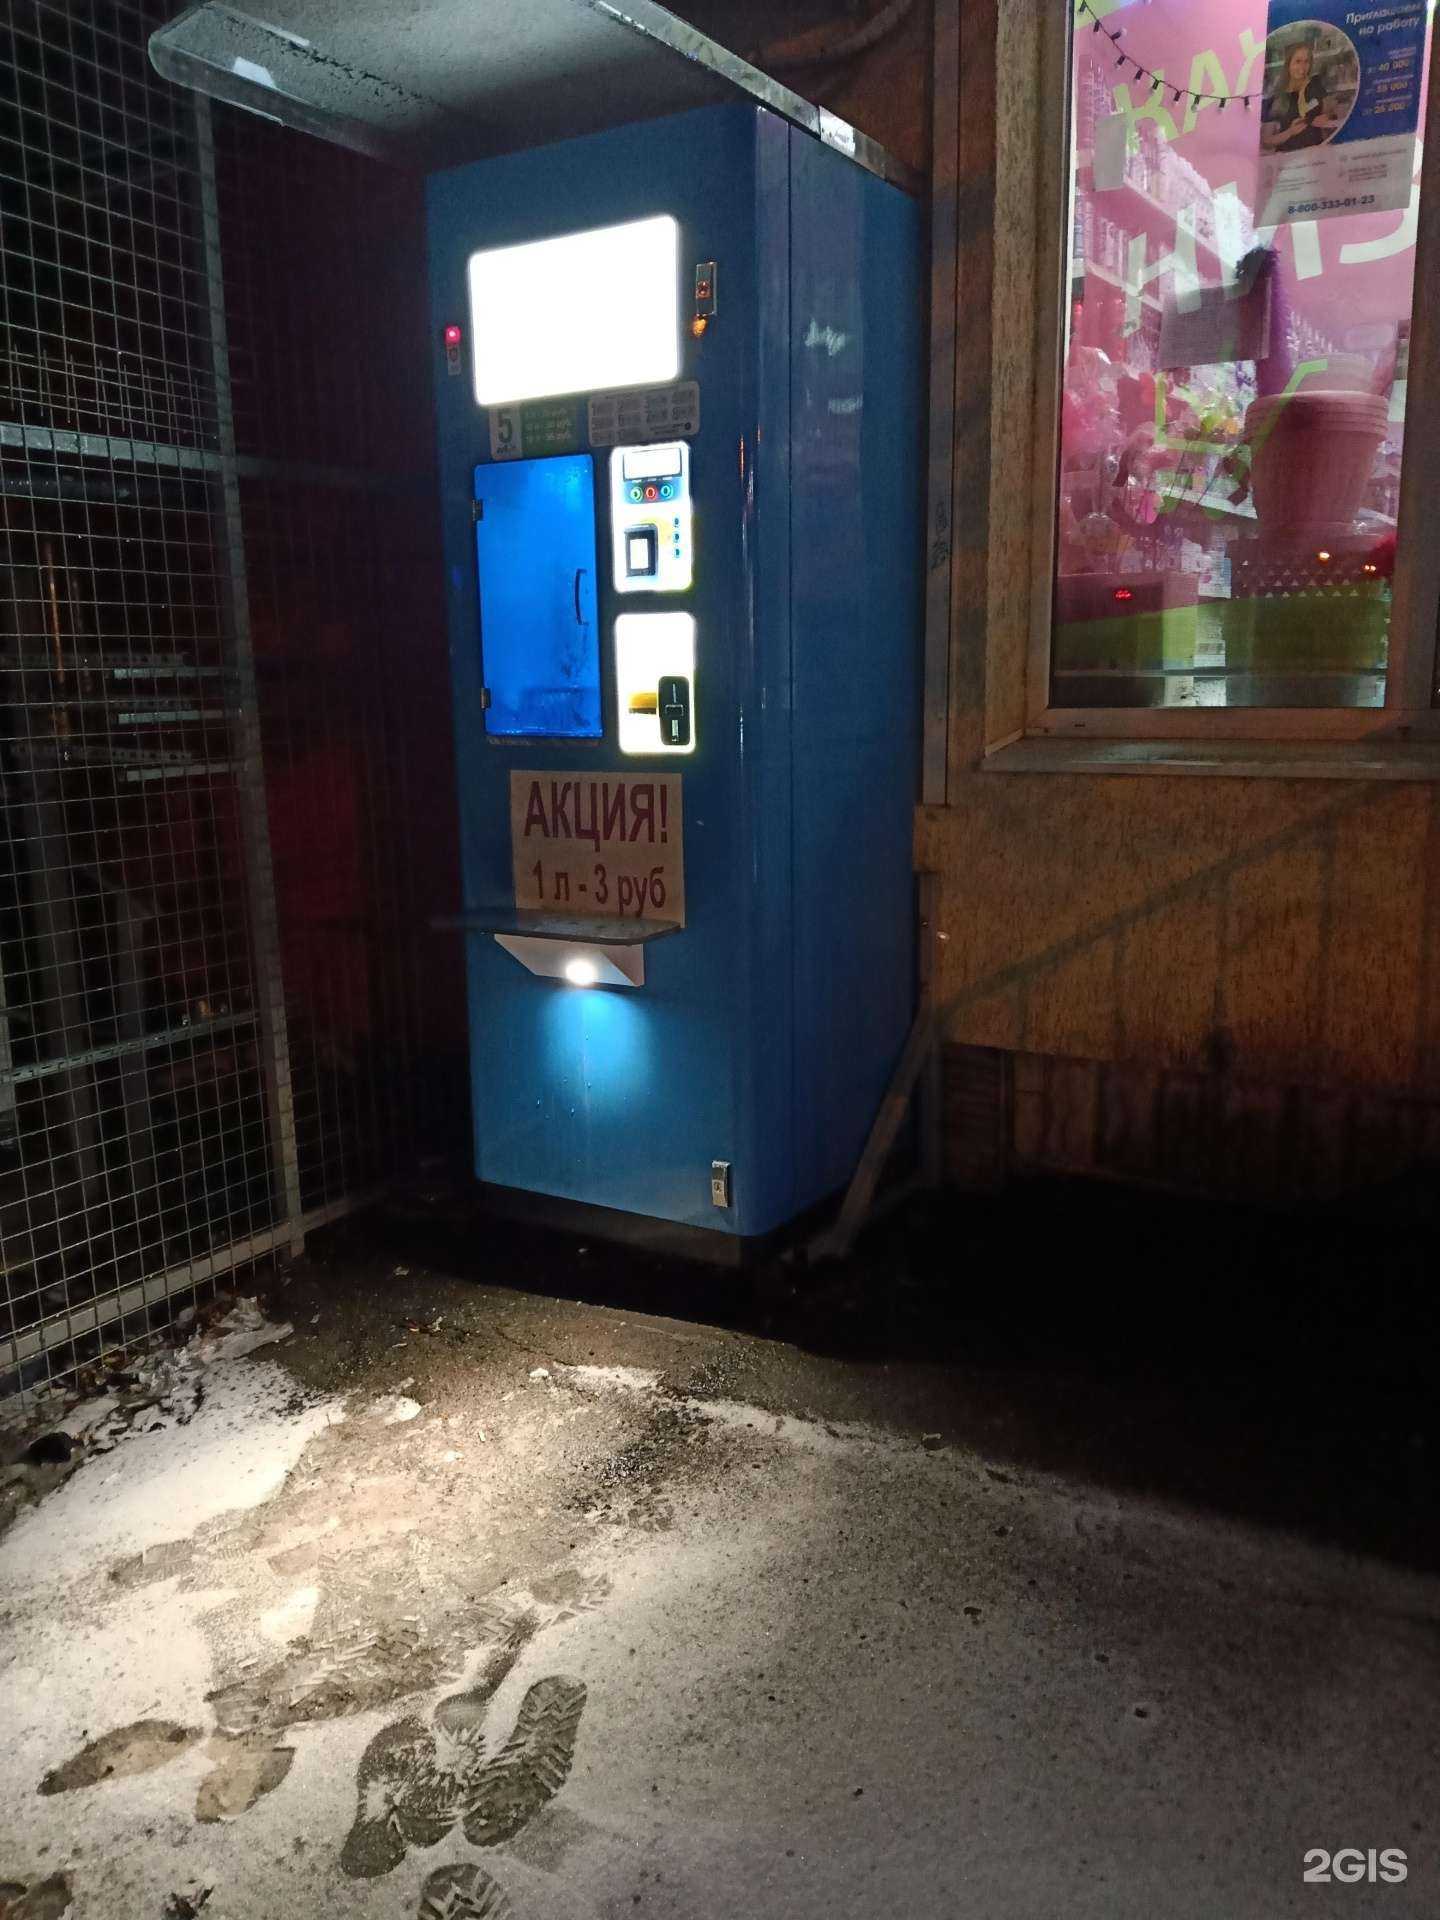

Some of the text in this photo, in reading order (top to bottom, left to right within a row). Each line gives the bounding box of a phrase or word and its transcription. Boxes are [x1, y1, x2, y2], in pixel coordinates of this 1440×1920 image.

[1377, 16, 1420, 35] работу
[1287, 194, 1376, 215] 8-800-333-01-23
[524, 780, 668, 853] АКЦИЯ!
[532, 860, 543, 899] 1
[554, 871, 569, 901] л
[595, 863, 608, 905] 3
[617, 866, 666, 918] руб
